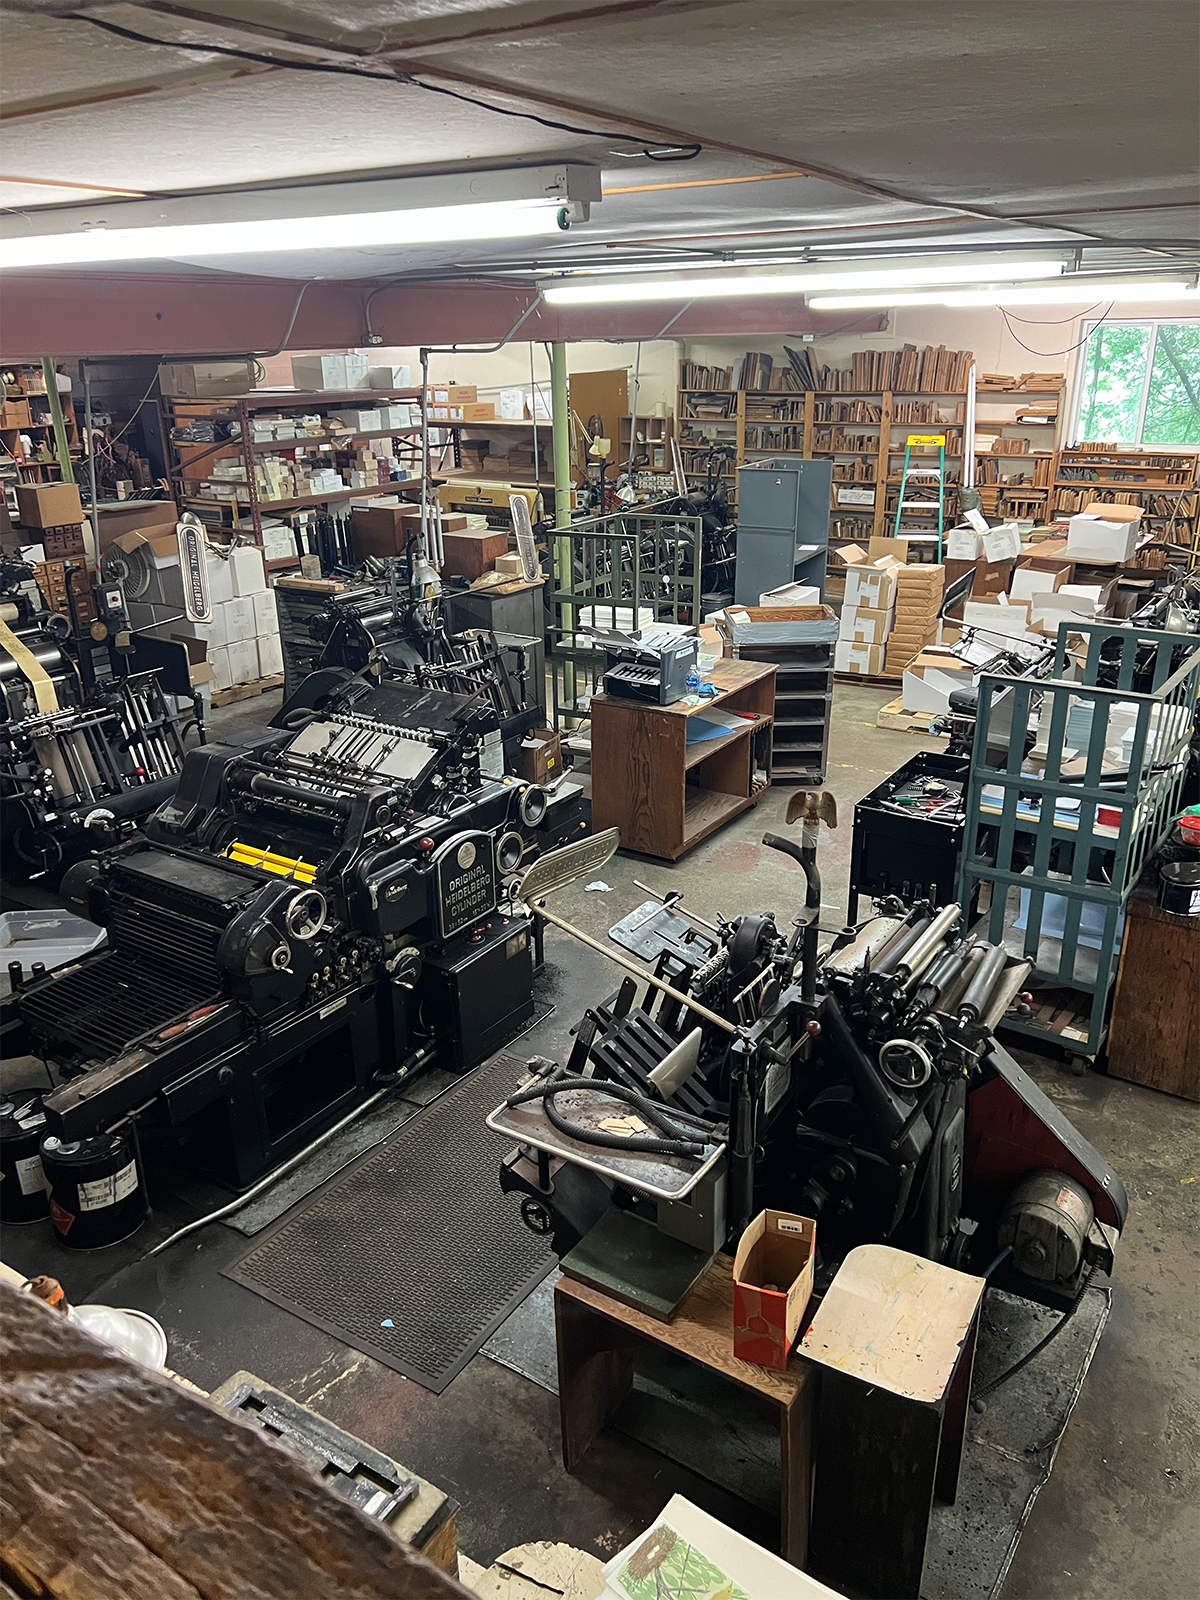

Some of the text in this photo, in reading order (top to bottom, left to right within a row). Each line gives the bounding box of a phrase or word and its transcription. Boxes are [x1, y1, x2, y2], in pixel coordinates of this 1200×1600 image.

[188, 536, 204, 611] ORIGINAL HEIDELBERG
[445, 874, 491, 908] HEIDELBERG
[449, 865, 486, 892] ORIGINAL
[451, 889, 487, 917] CYLINDER
